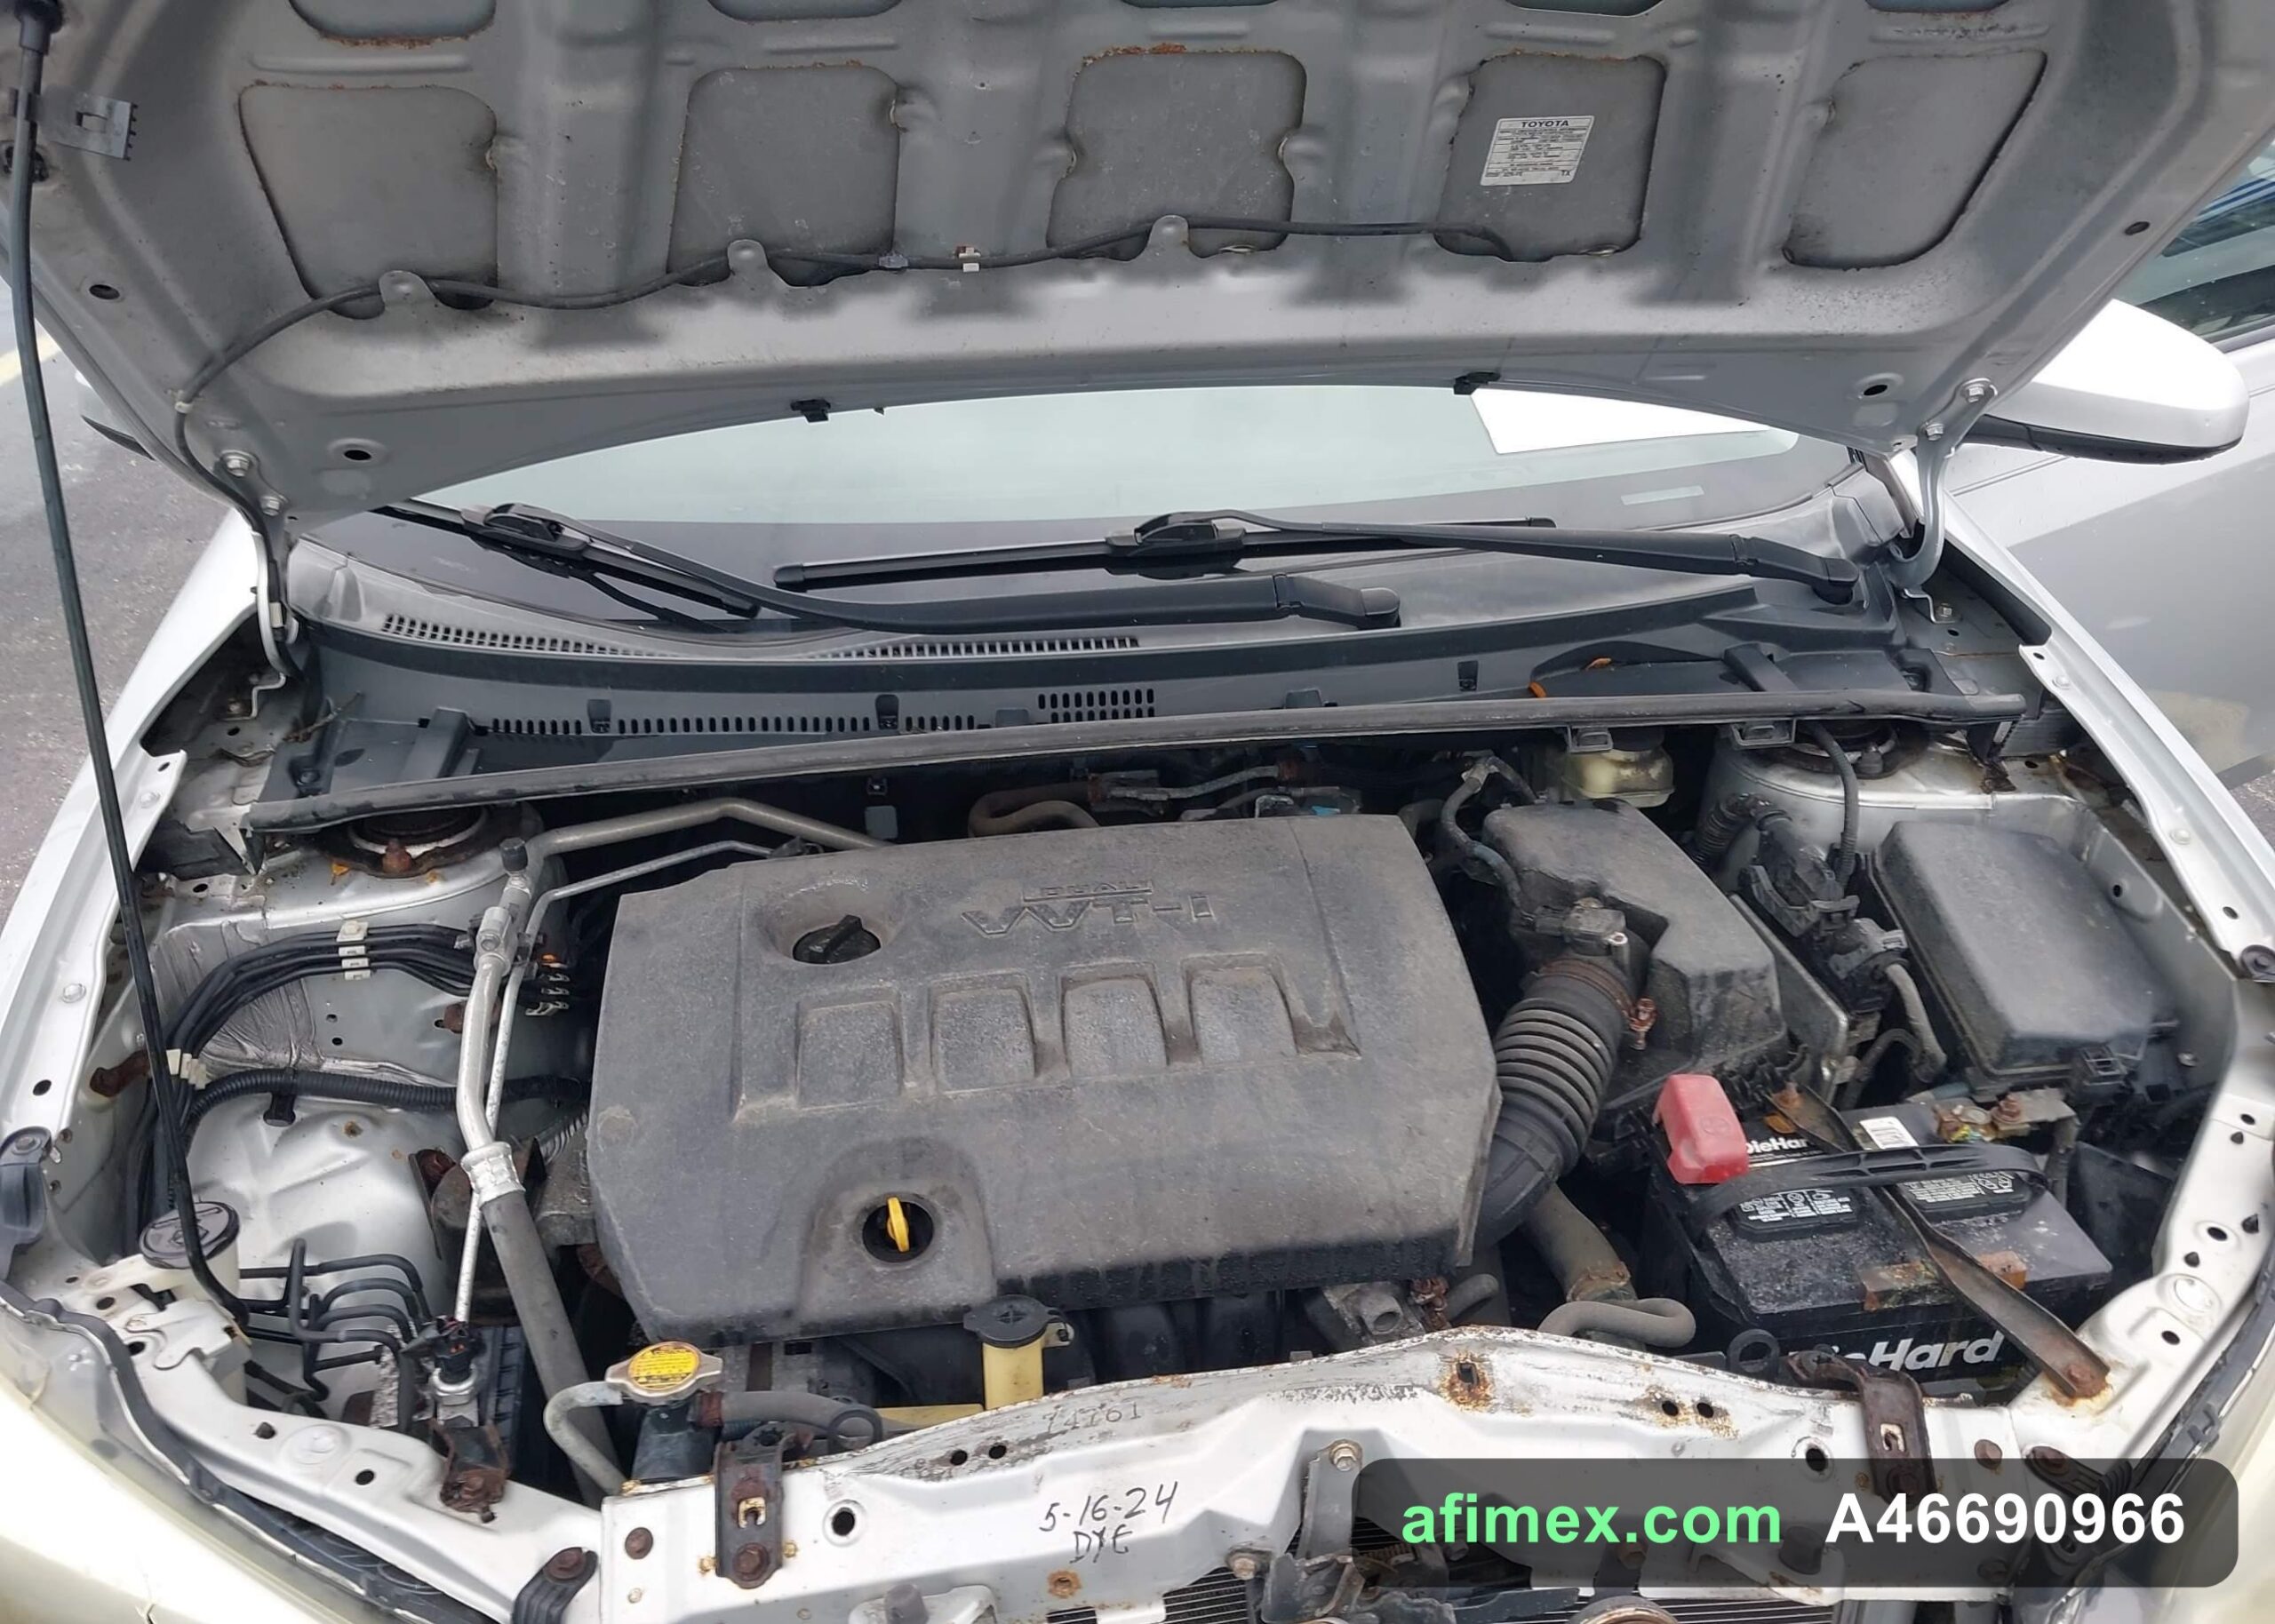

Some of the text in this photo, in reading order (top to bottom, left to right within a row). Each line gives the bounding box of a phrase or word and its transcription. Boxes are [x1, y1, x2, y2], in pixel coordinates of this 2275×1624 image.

[1745, 1136, 1816, 1154] DieHar
[1788, 1330, 2006, 1372] Hard
[1039, 1481, 1178, 1532] 5-16-24
[1068, 1524, 1133, 1564] DYE
